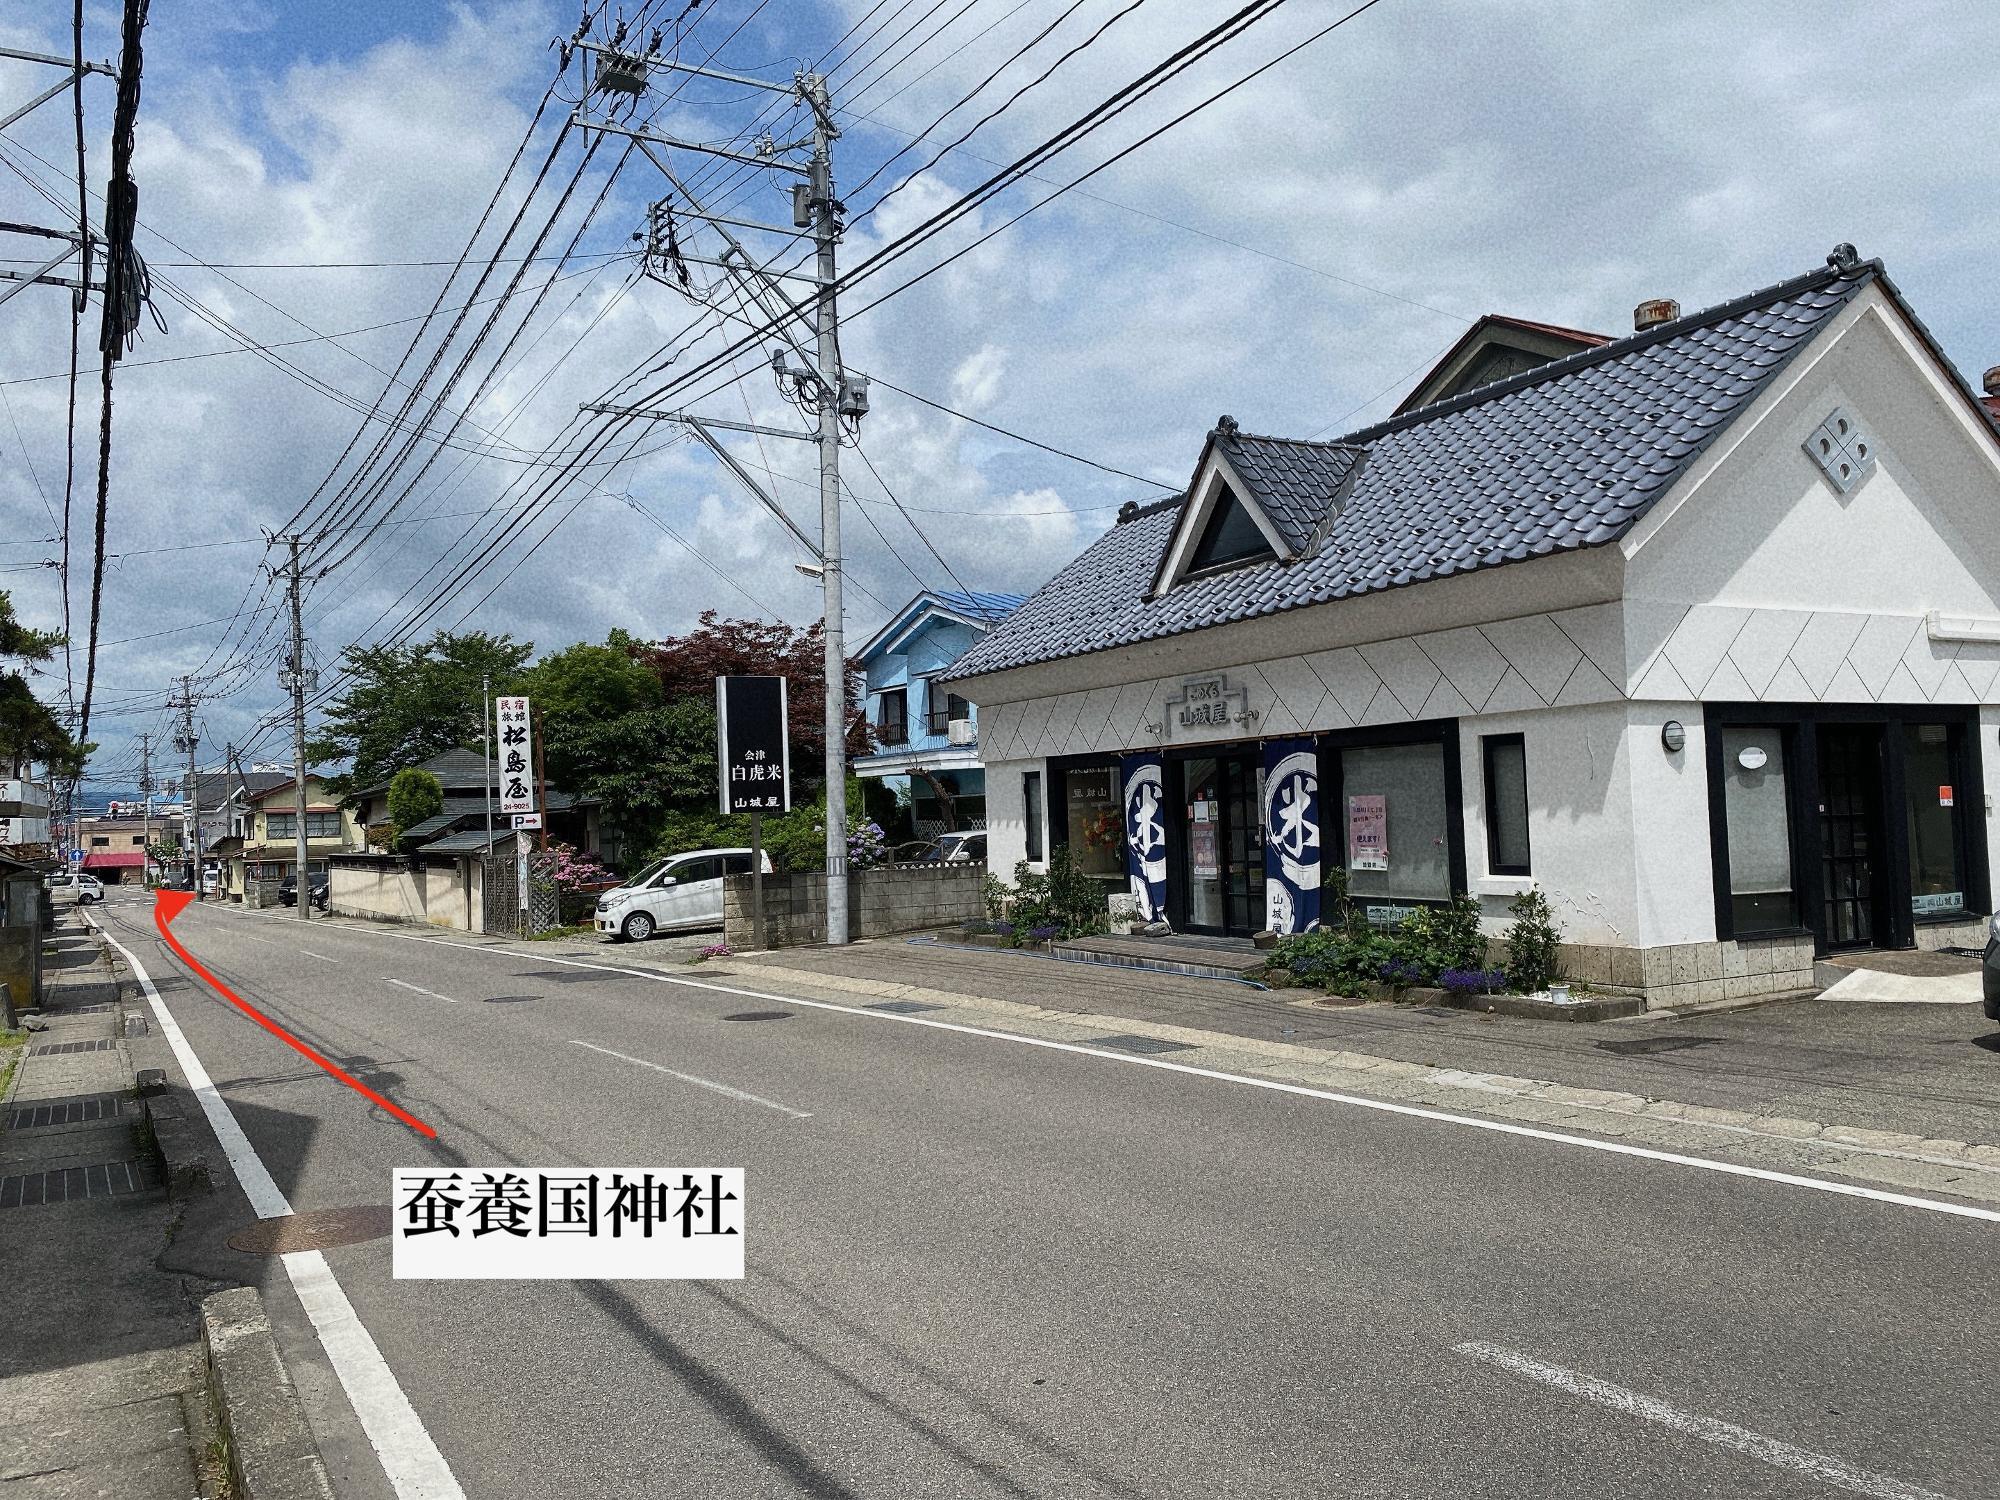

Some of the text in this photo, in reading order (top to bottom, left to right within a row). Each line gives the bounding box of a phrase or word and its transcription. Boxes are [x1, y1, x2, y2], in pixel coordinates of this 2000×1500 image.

[500, 700, 524, 711] 民宿
[501, 712, 526, 722] 旅館
[1179, 702, 1230, 726] 山城屋
[744, 750, 766, 761] 会津
[502, 725, 529, 799] 松島屋
[732, 764, 782, 781] 白虎米
[503, 803, 530, 811] 24-9025
[734, 797, 781, 808] 山城屋
[514, 816, 524, 828] P
[1130, 783, 1166, 858] 米
[1272, 774, 1320, 859] 米
